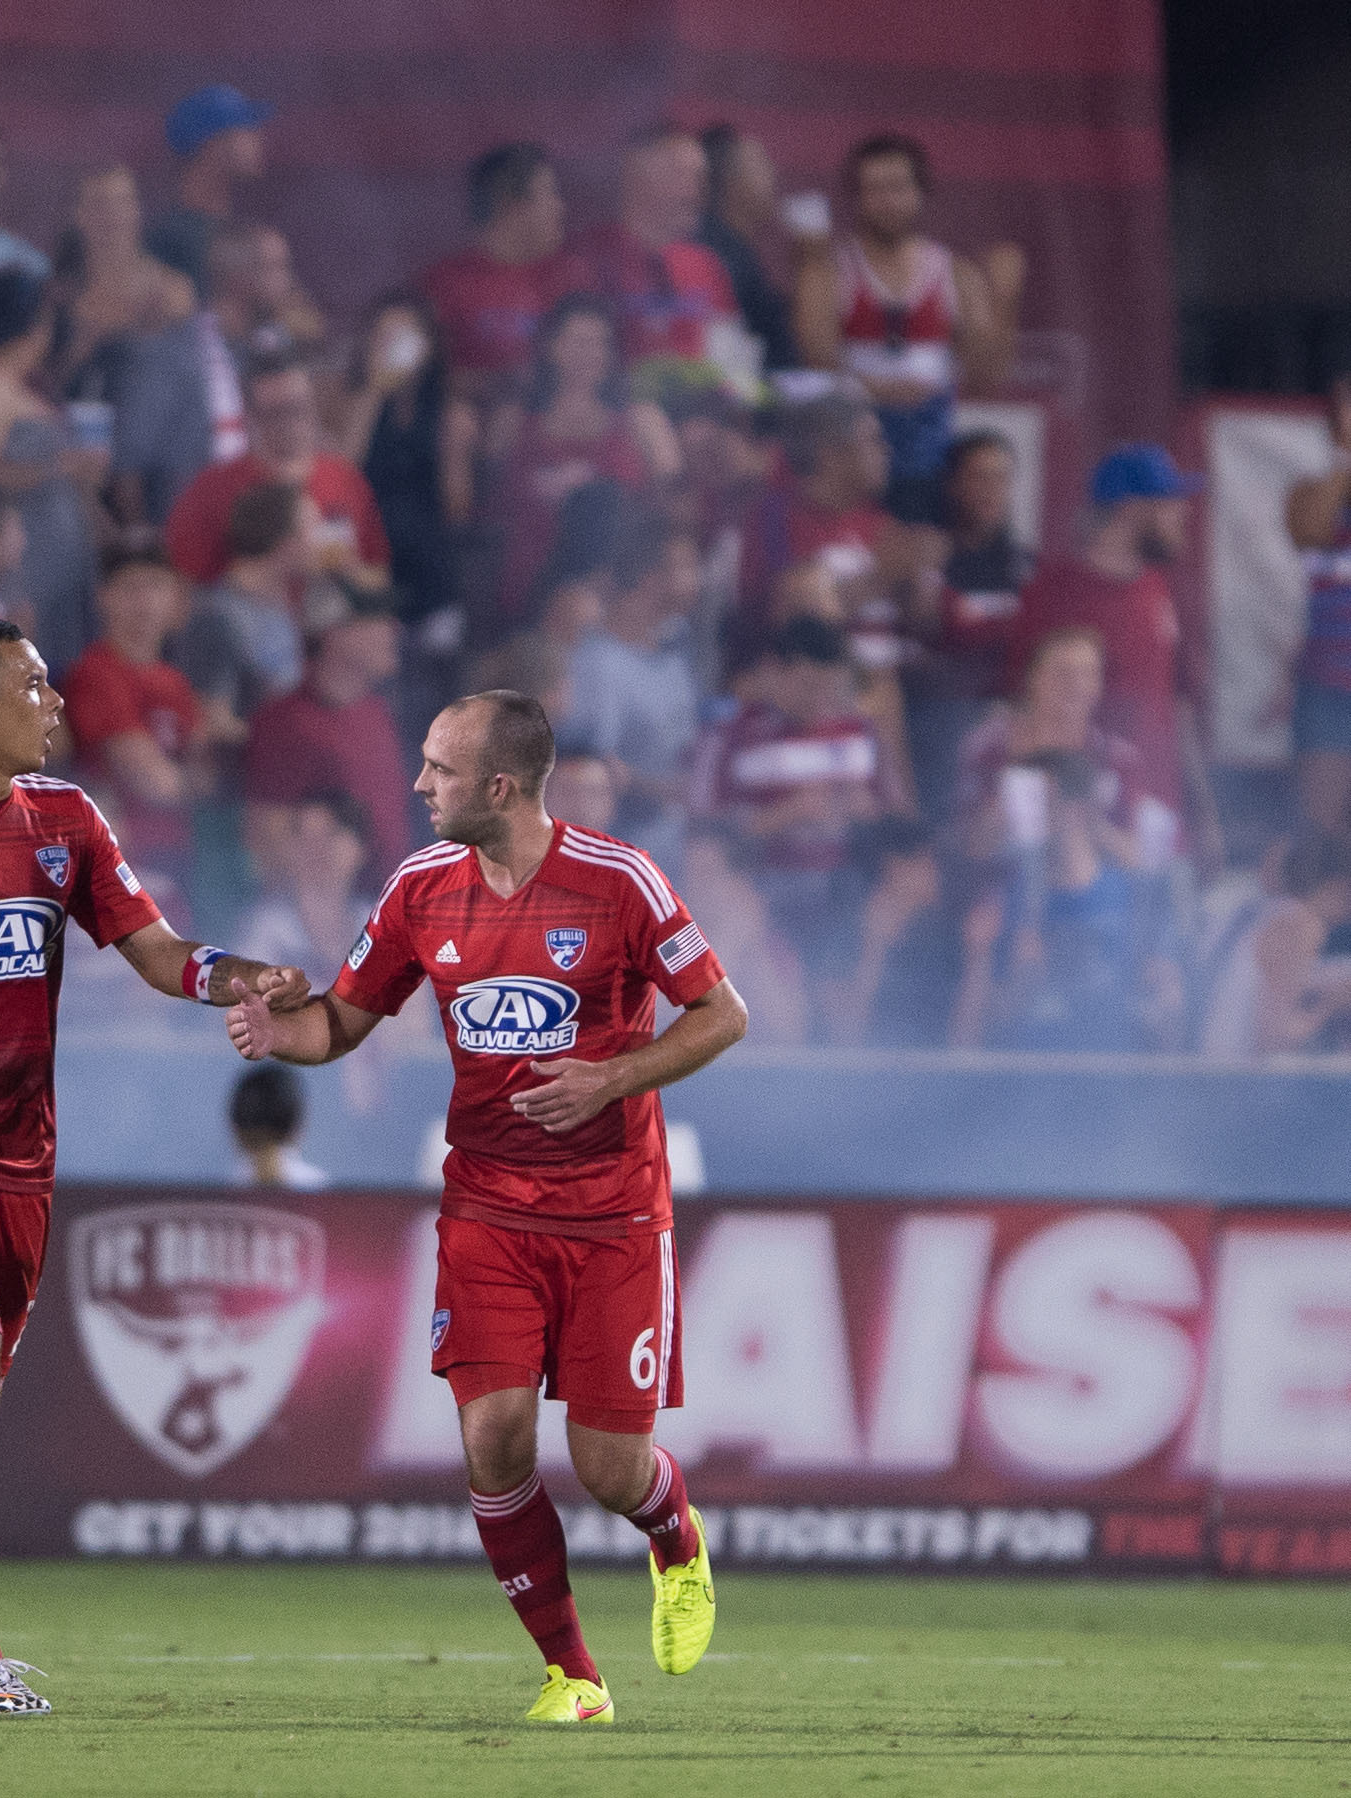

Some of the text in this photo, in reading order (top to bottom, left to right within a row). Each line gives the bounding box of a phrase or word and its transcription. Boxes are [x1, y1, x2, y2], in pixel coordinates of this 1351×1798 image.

[549, 931, 583, 943] FC DALLAS
[436, 955, 461, 964] adidas
[460, 1027, 572, 1049] ADVOCARE
[629, 1327, 657, 1390] 6
[73, 1501, 190, 1556] GET
[201, 1501, 353, 1556] YOUR
[732, 1506, 969, 1560] TICKETS
[977, 1507, 1094, 1561] FOR
[500, 1573, 533, 1597] CD
